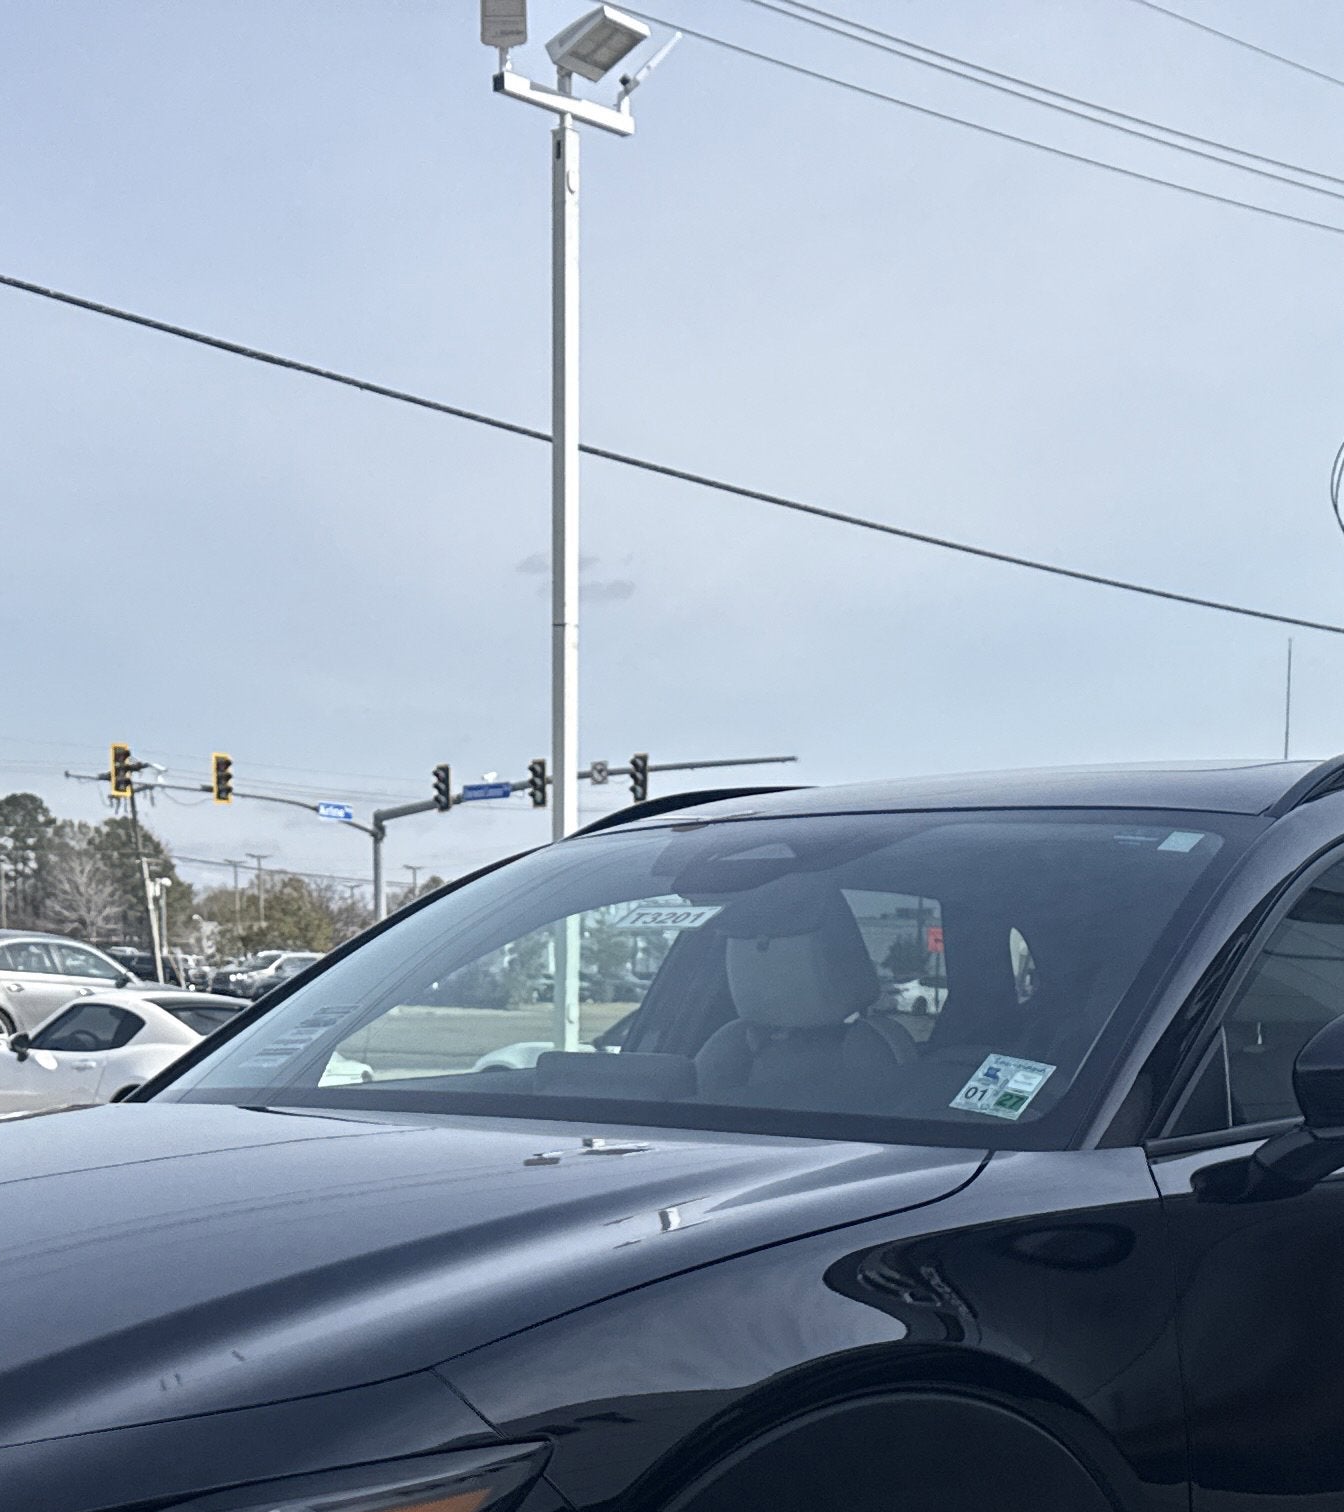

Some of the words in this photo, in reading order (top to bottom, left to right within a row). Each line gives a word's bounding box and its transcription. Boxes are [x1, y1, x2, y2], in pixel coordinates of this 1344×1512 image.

[630, 911, 707, 925] T3201
[964, 1086, 988, 1102] 01
[1000, 1093, 1024, 1110] 27
